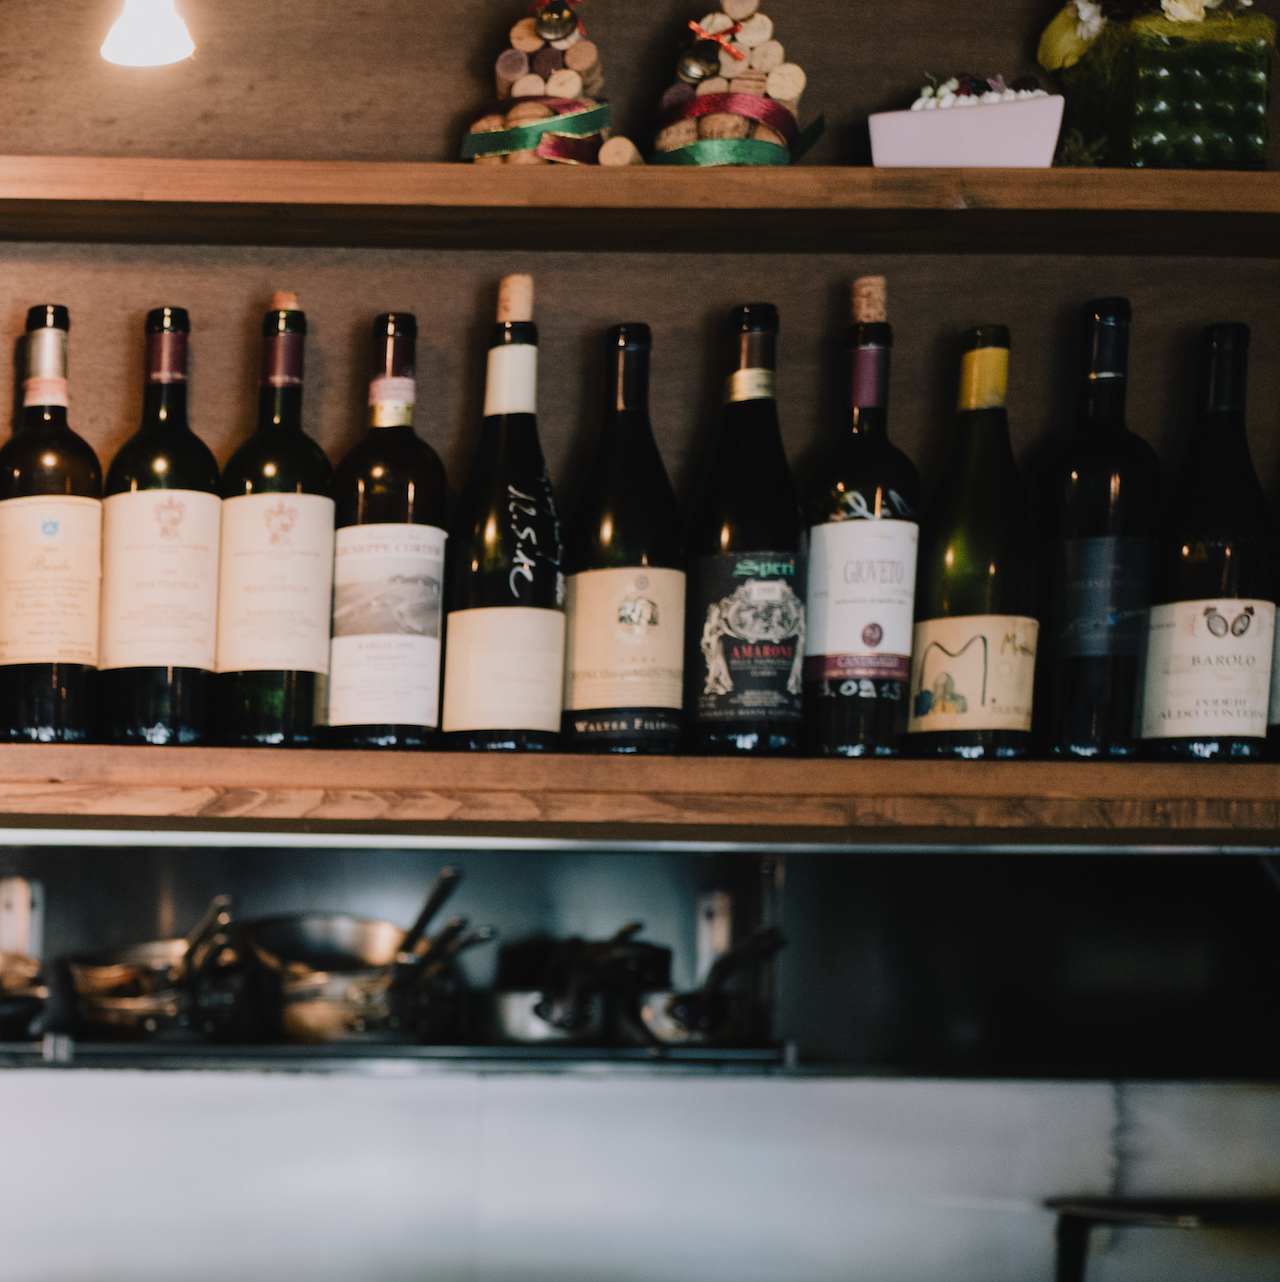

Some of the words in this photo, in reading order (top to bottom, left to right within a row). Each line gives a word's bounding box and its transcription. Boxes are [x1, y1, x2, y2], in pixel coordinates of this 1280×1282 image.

[733, 558, 796, 578] Speri
[730, 645, 793, 660] AMARONE
[1191, 655, 1256, 668] BAROLO
